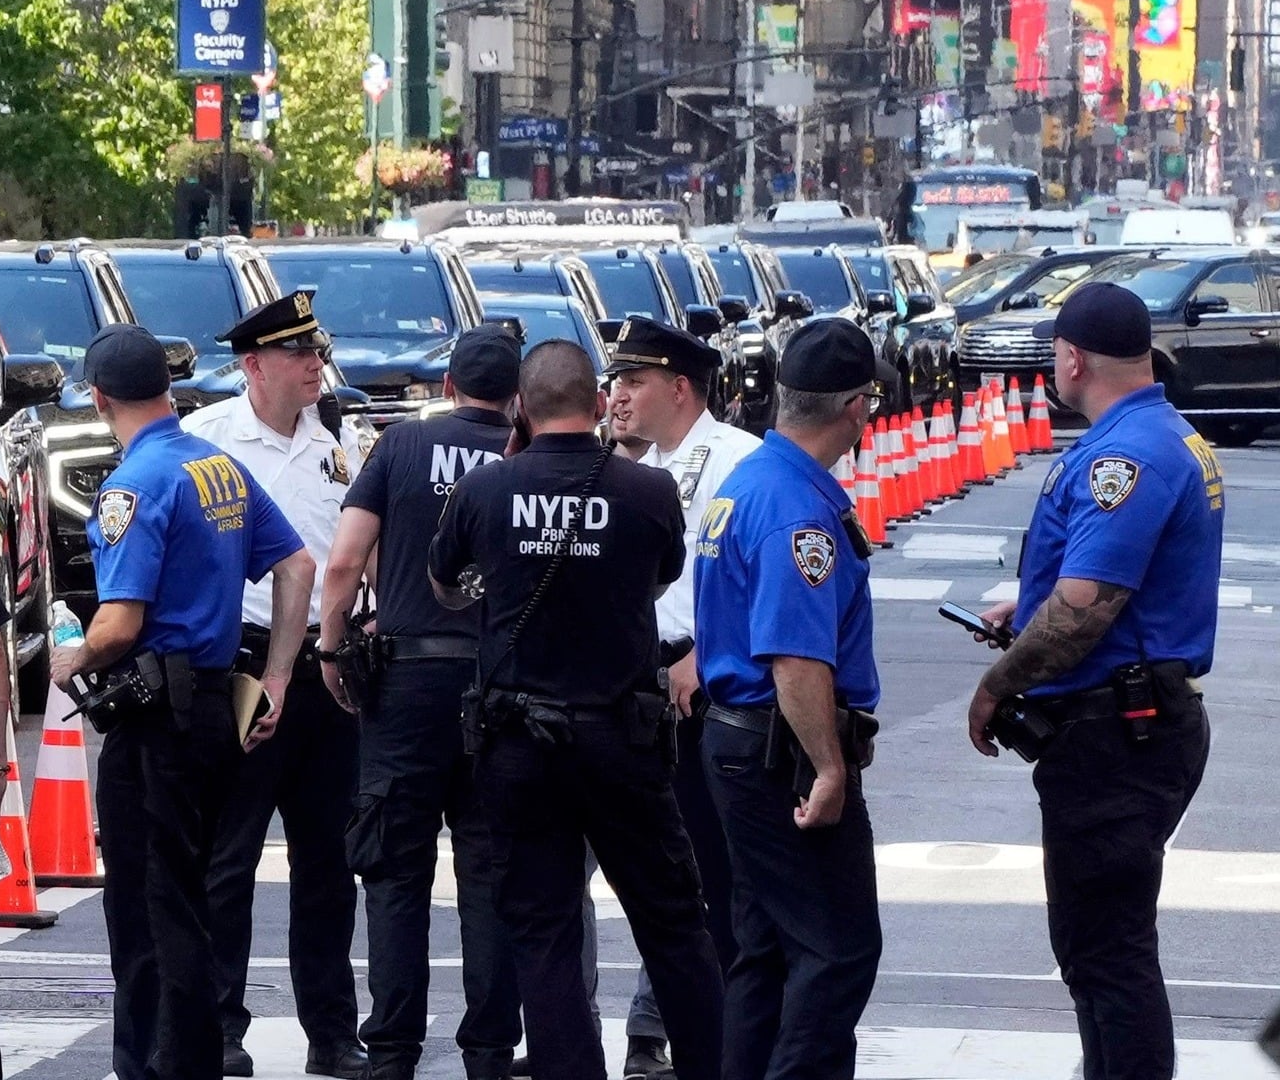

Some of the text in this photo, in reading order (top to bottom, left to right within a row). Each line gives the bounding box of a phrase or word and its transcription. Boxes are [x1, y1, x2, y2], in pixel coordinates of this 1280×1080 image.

[194, 33, 246, 49] Security
[195, 48, 244, 61] Camera
[465, 208, 665, 226] Uber Shuttle LGA NYC
[181, 454, 247, 508] NYPD
[204, 502, 248, 522] COMMUNITY
[512, 494, 609, 530] NYPD
[217, 516, 244, 533] AFFAIRS
